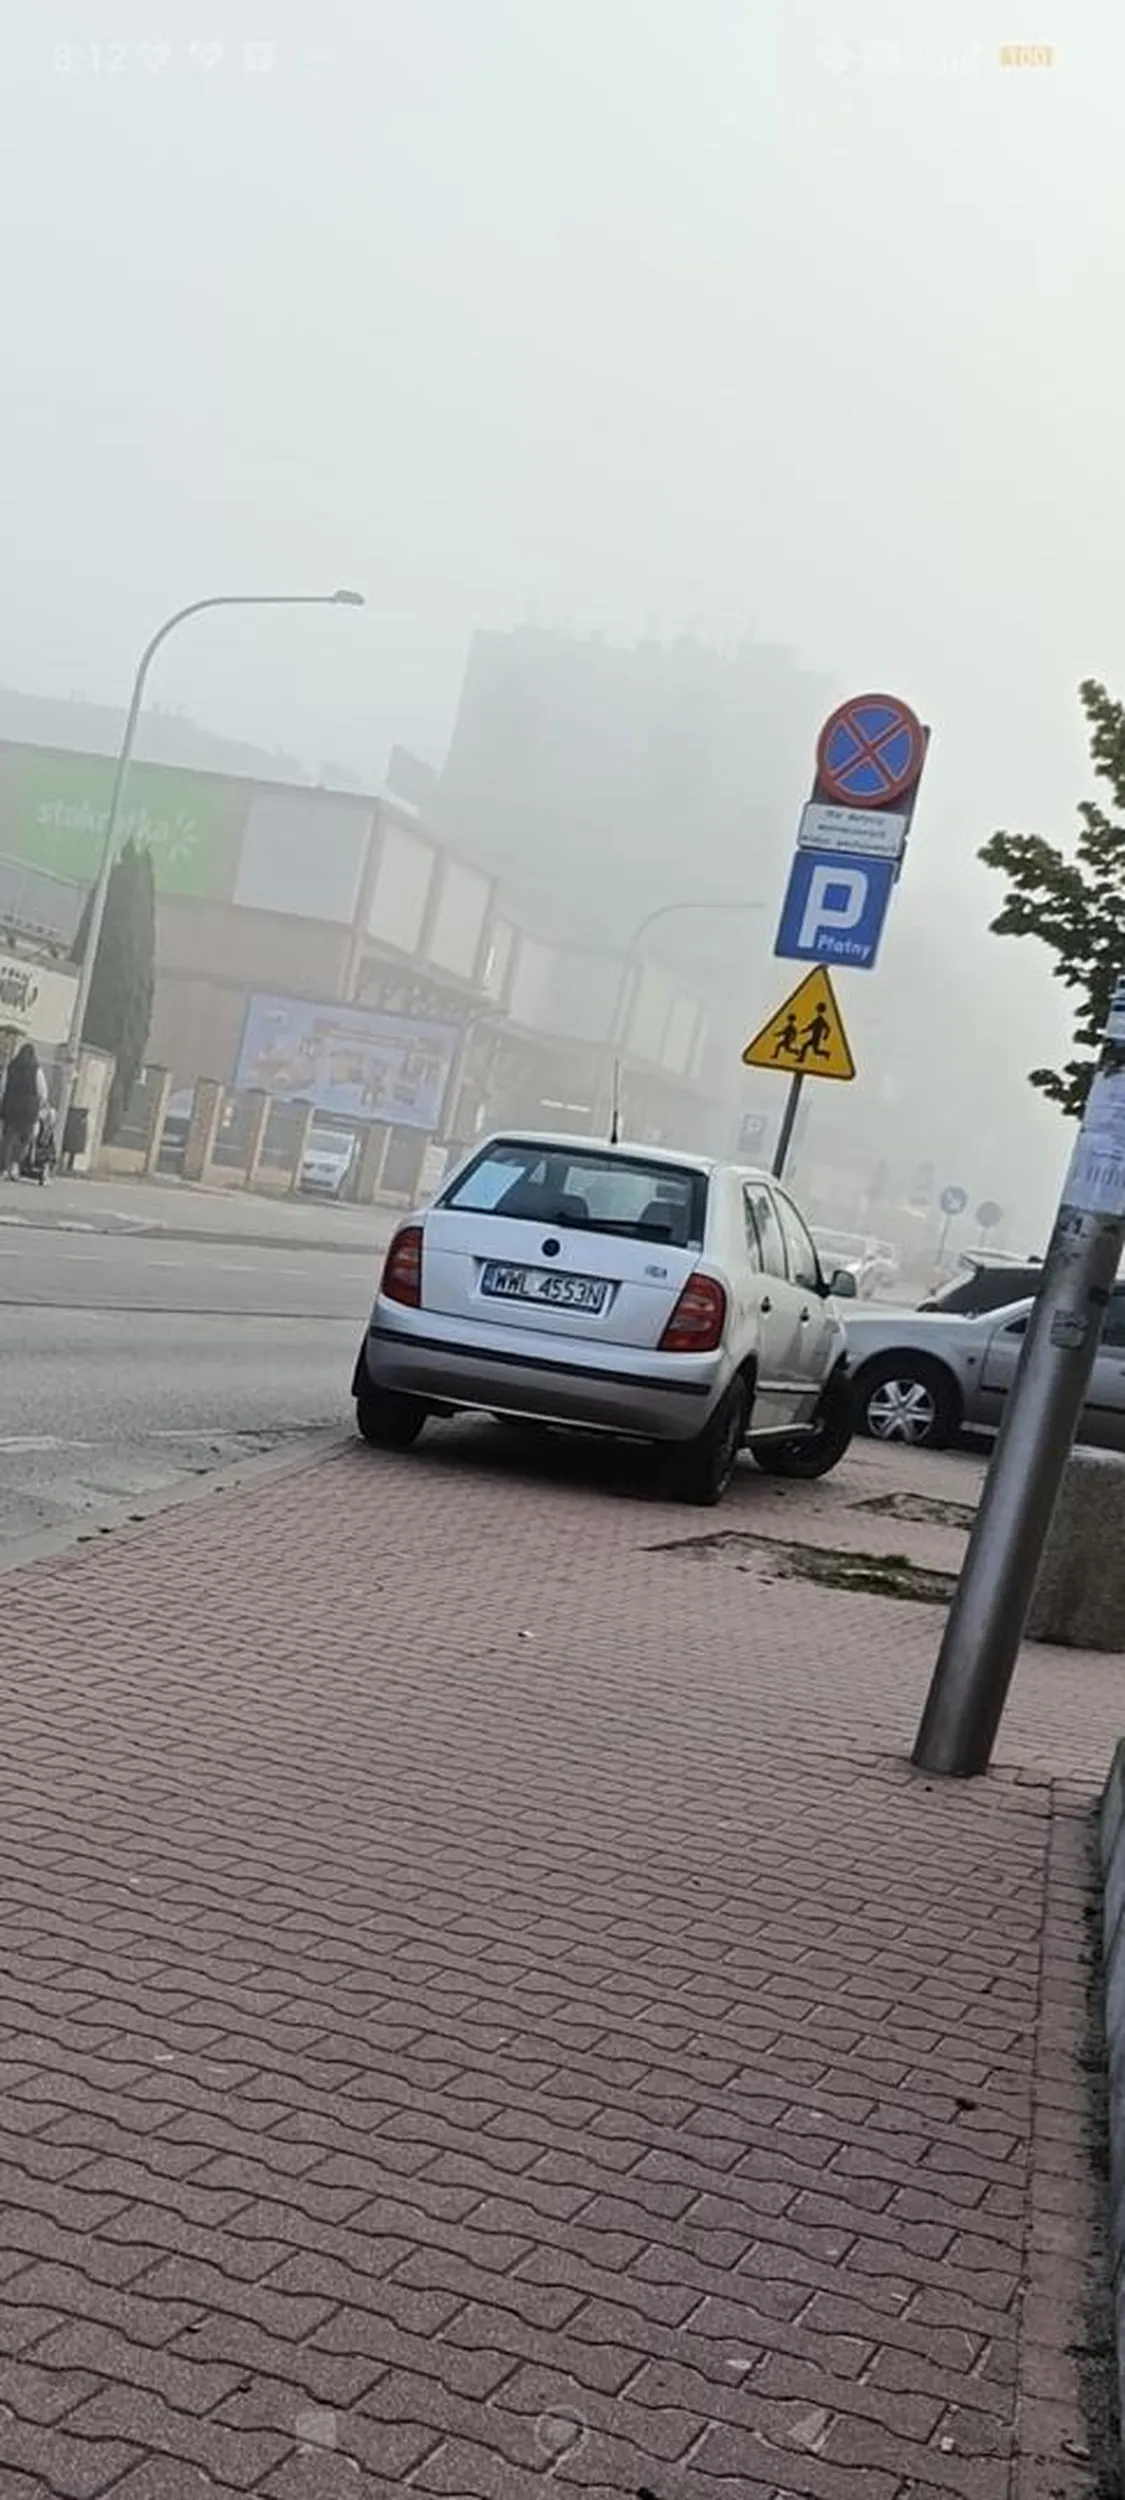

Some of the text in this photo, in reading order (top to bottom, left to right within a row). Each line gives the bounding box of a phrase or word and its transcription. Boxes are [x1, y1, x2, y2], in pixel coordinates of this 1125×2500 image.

[797, 865, 869, 949] P
[494, 1270, 603, 1307] WWL 4553N
